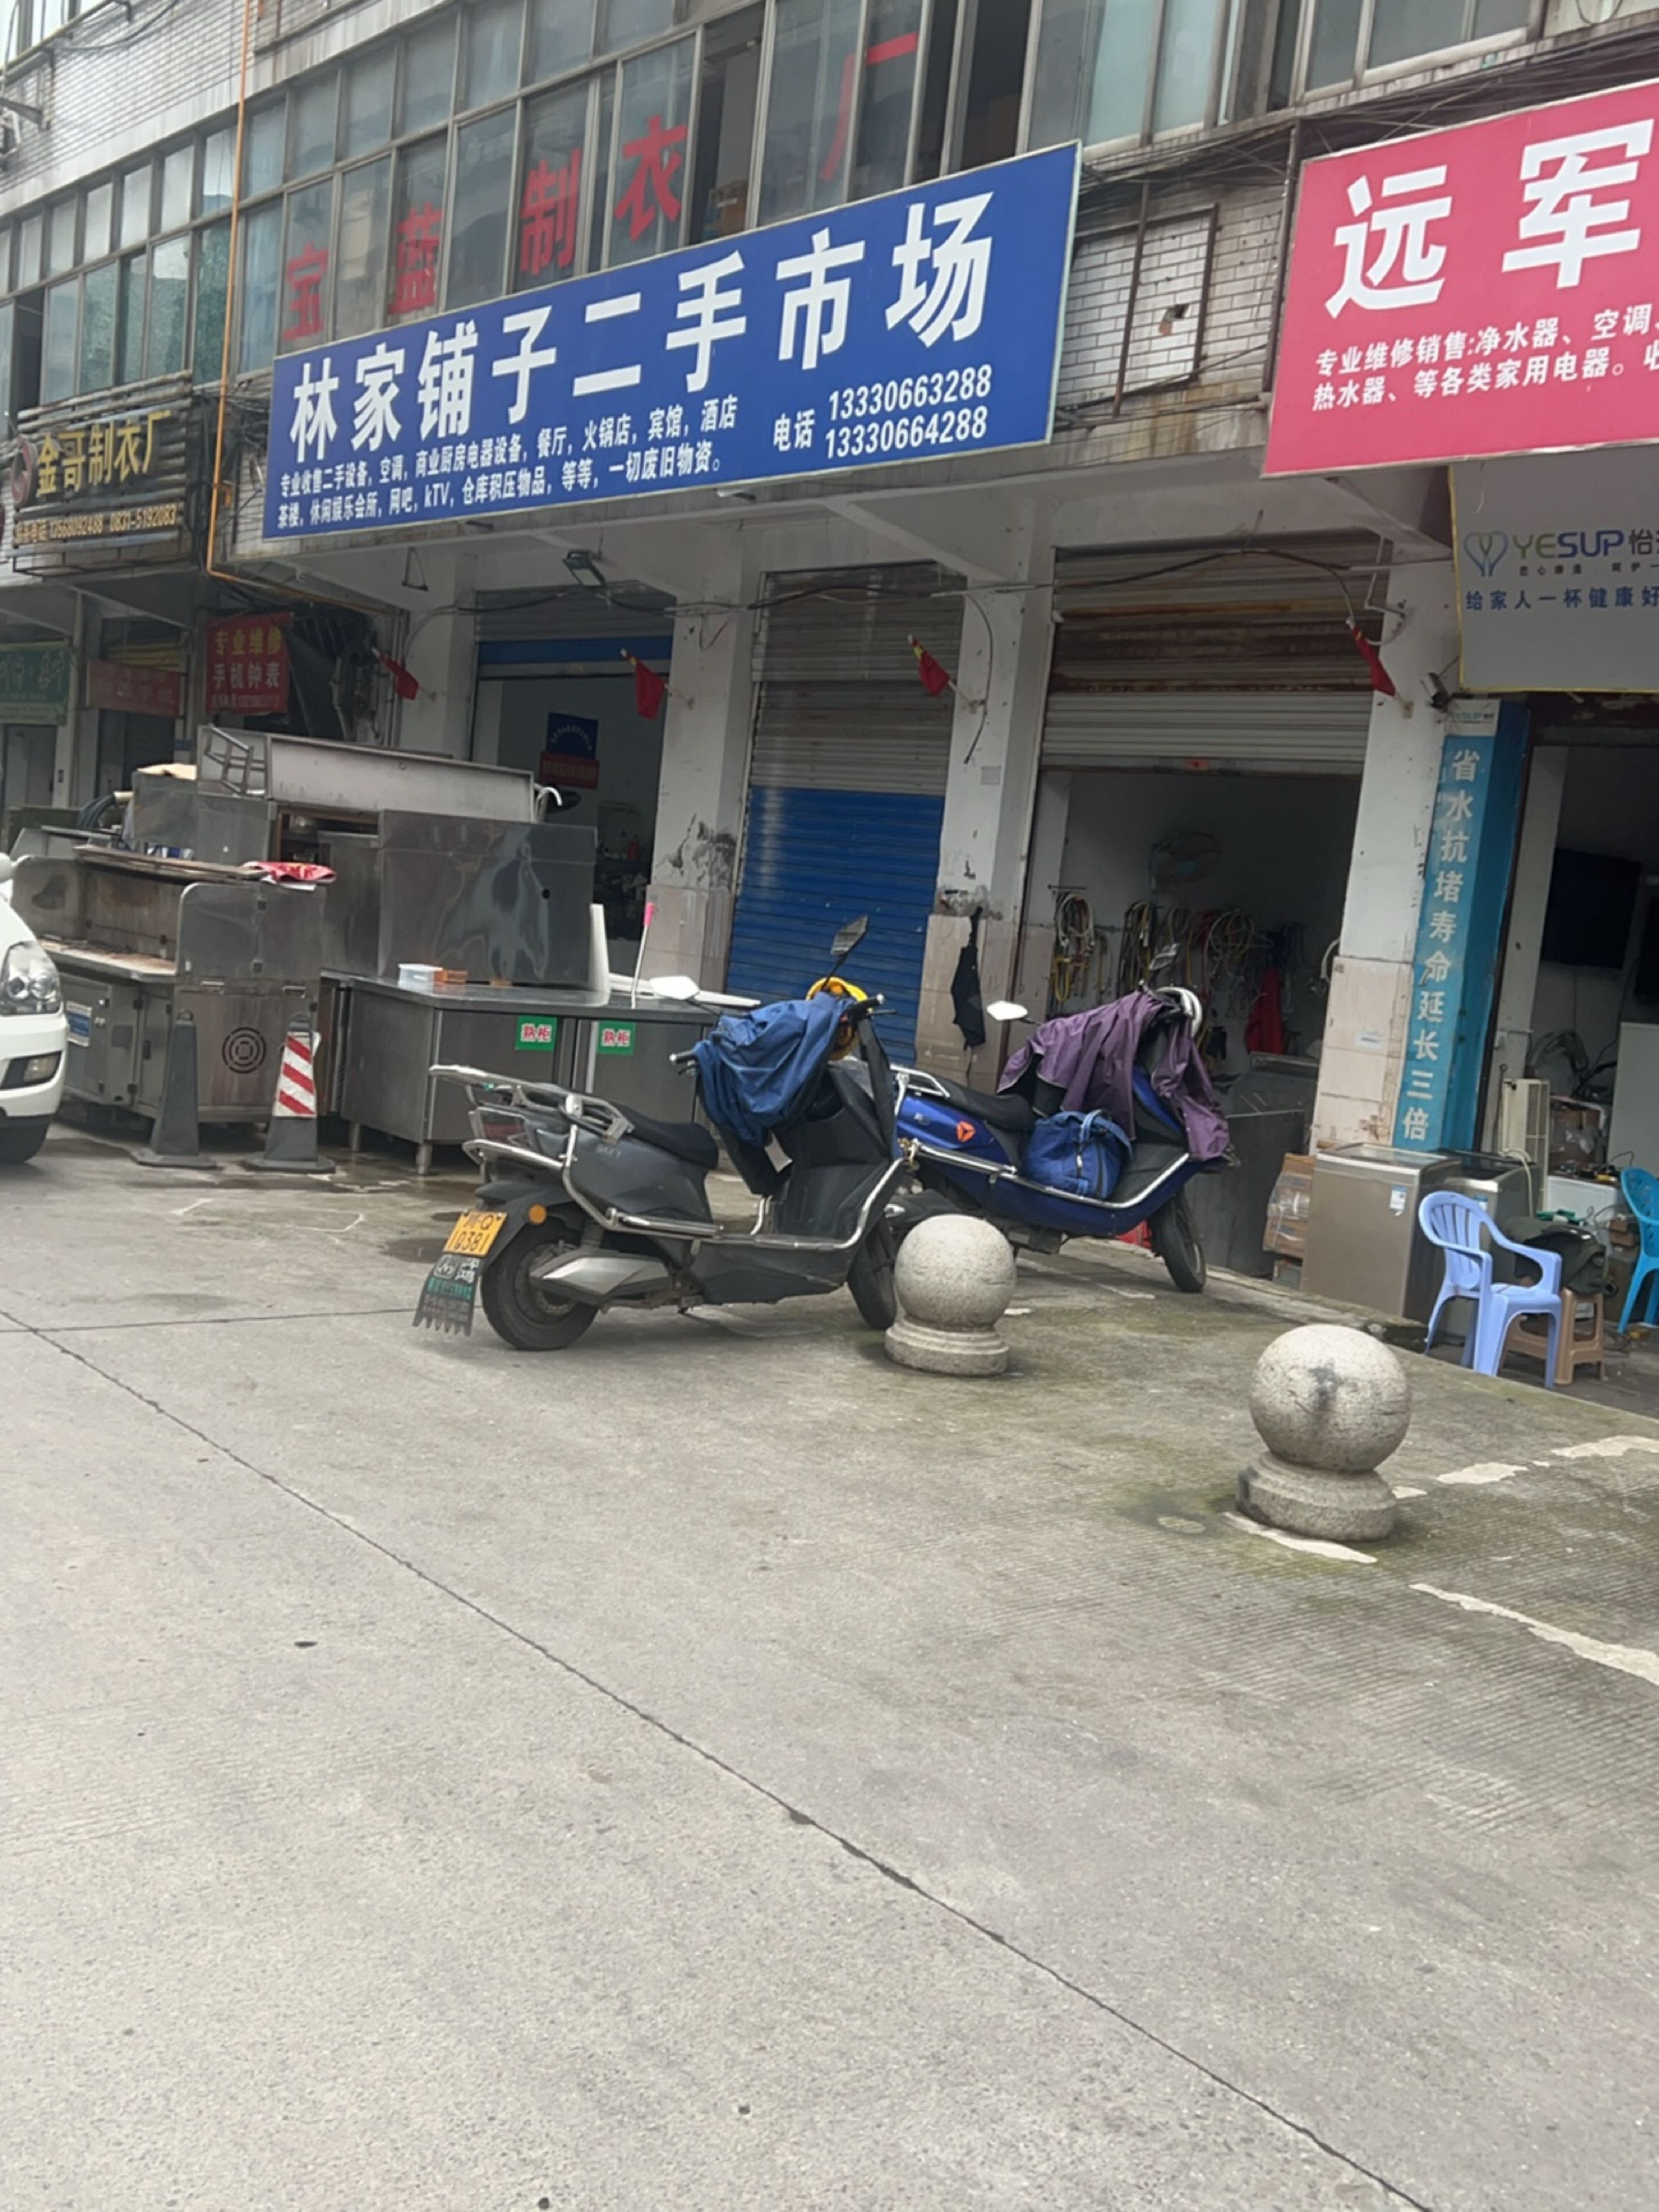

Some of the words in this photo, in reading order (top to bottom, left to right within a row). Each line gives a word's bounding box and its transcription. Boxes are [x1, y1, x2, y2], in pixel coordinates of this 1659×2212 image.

[1324, 118, 1655, 319] 远军
[289, 191, 994, 463] 林家铺子二手市场
[773, 408, 815, 452] 电话
[828, 364, 993, 421] 13330663288
[825, 405, 988, 459] 13330664288
[36, 410, 172, 498] 金哥制衣厂
[1513, 529, 1625, 559] YESUP
[1628, 527, 1659, 556] 怡
[1466, 585, 1659, 612] 给家人一杯健康好
[1402, 748, 1481, 1142] 省水抗堵寿命延长三倍
